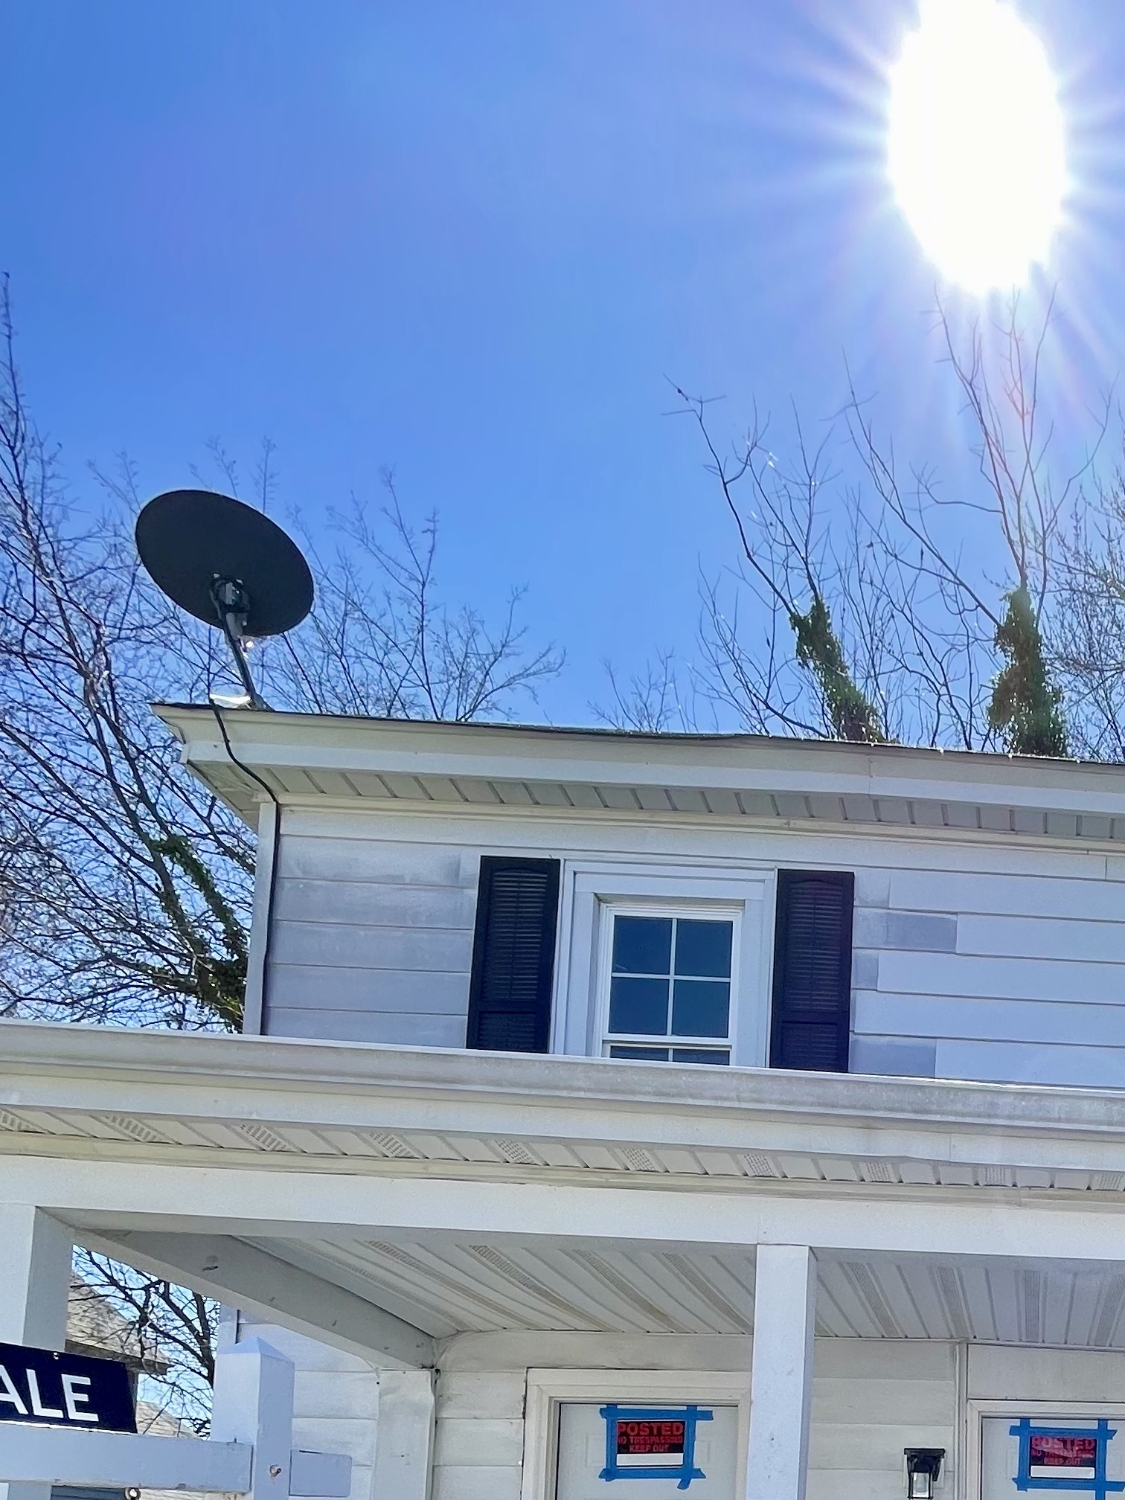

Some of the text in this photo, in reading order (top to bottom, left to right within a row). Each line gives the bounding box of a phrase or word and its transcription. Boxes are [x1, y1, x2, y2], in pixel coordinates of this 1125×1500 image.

[618, 1422, 684, 1436] POSTED
[629, 1444, 670, 1453] KEEP OUT
